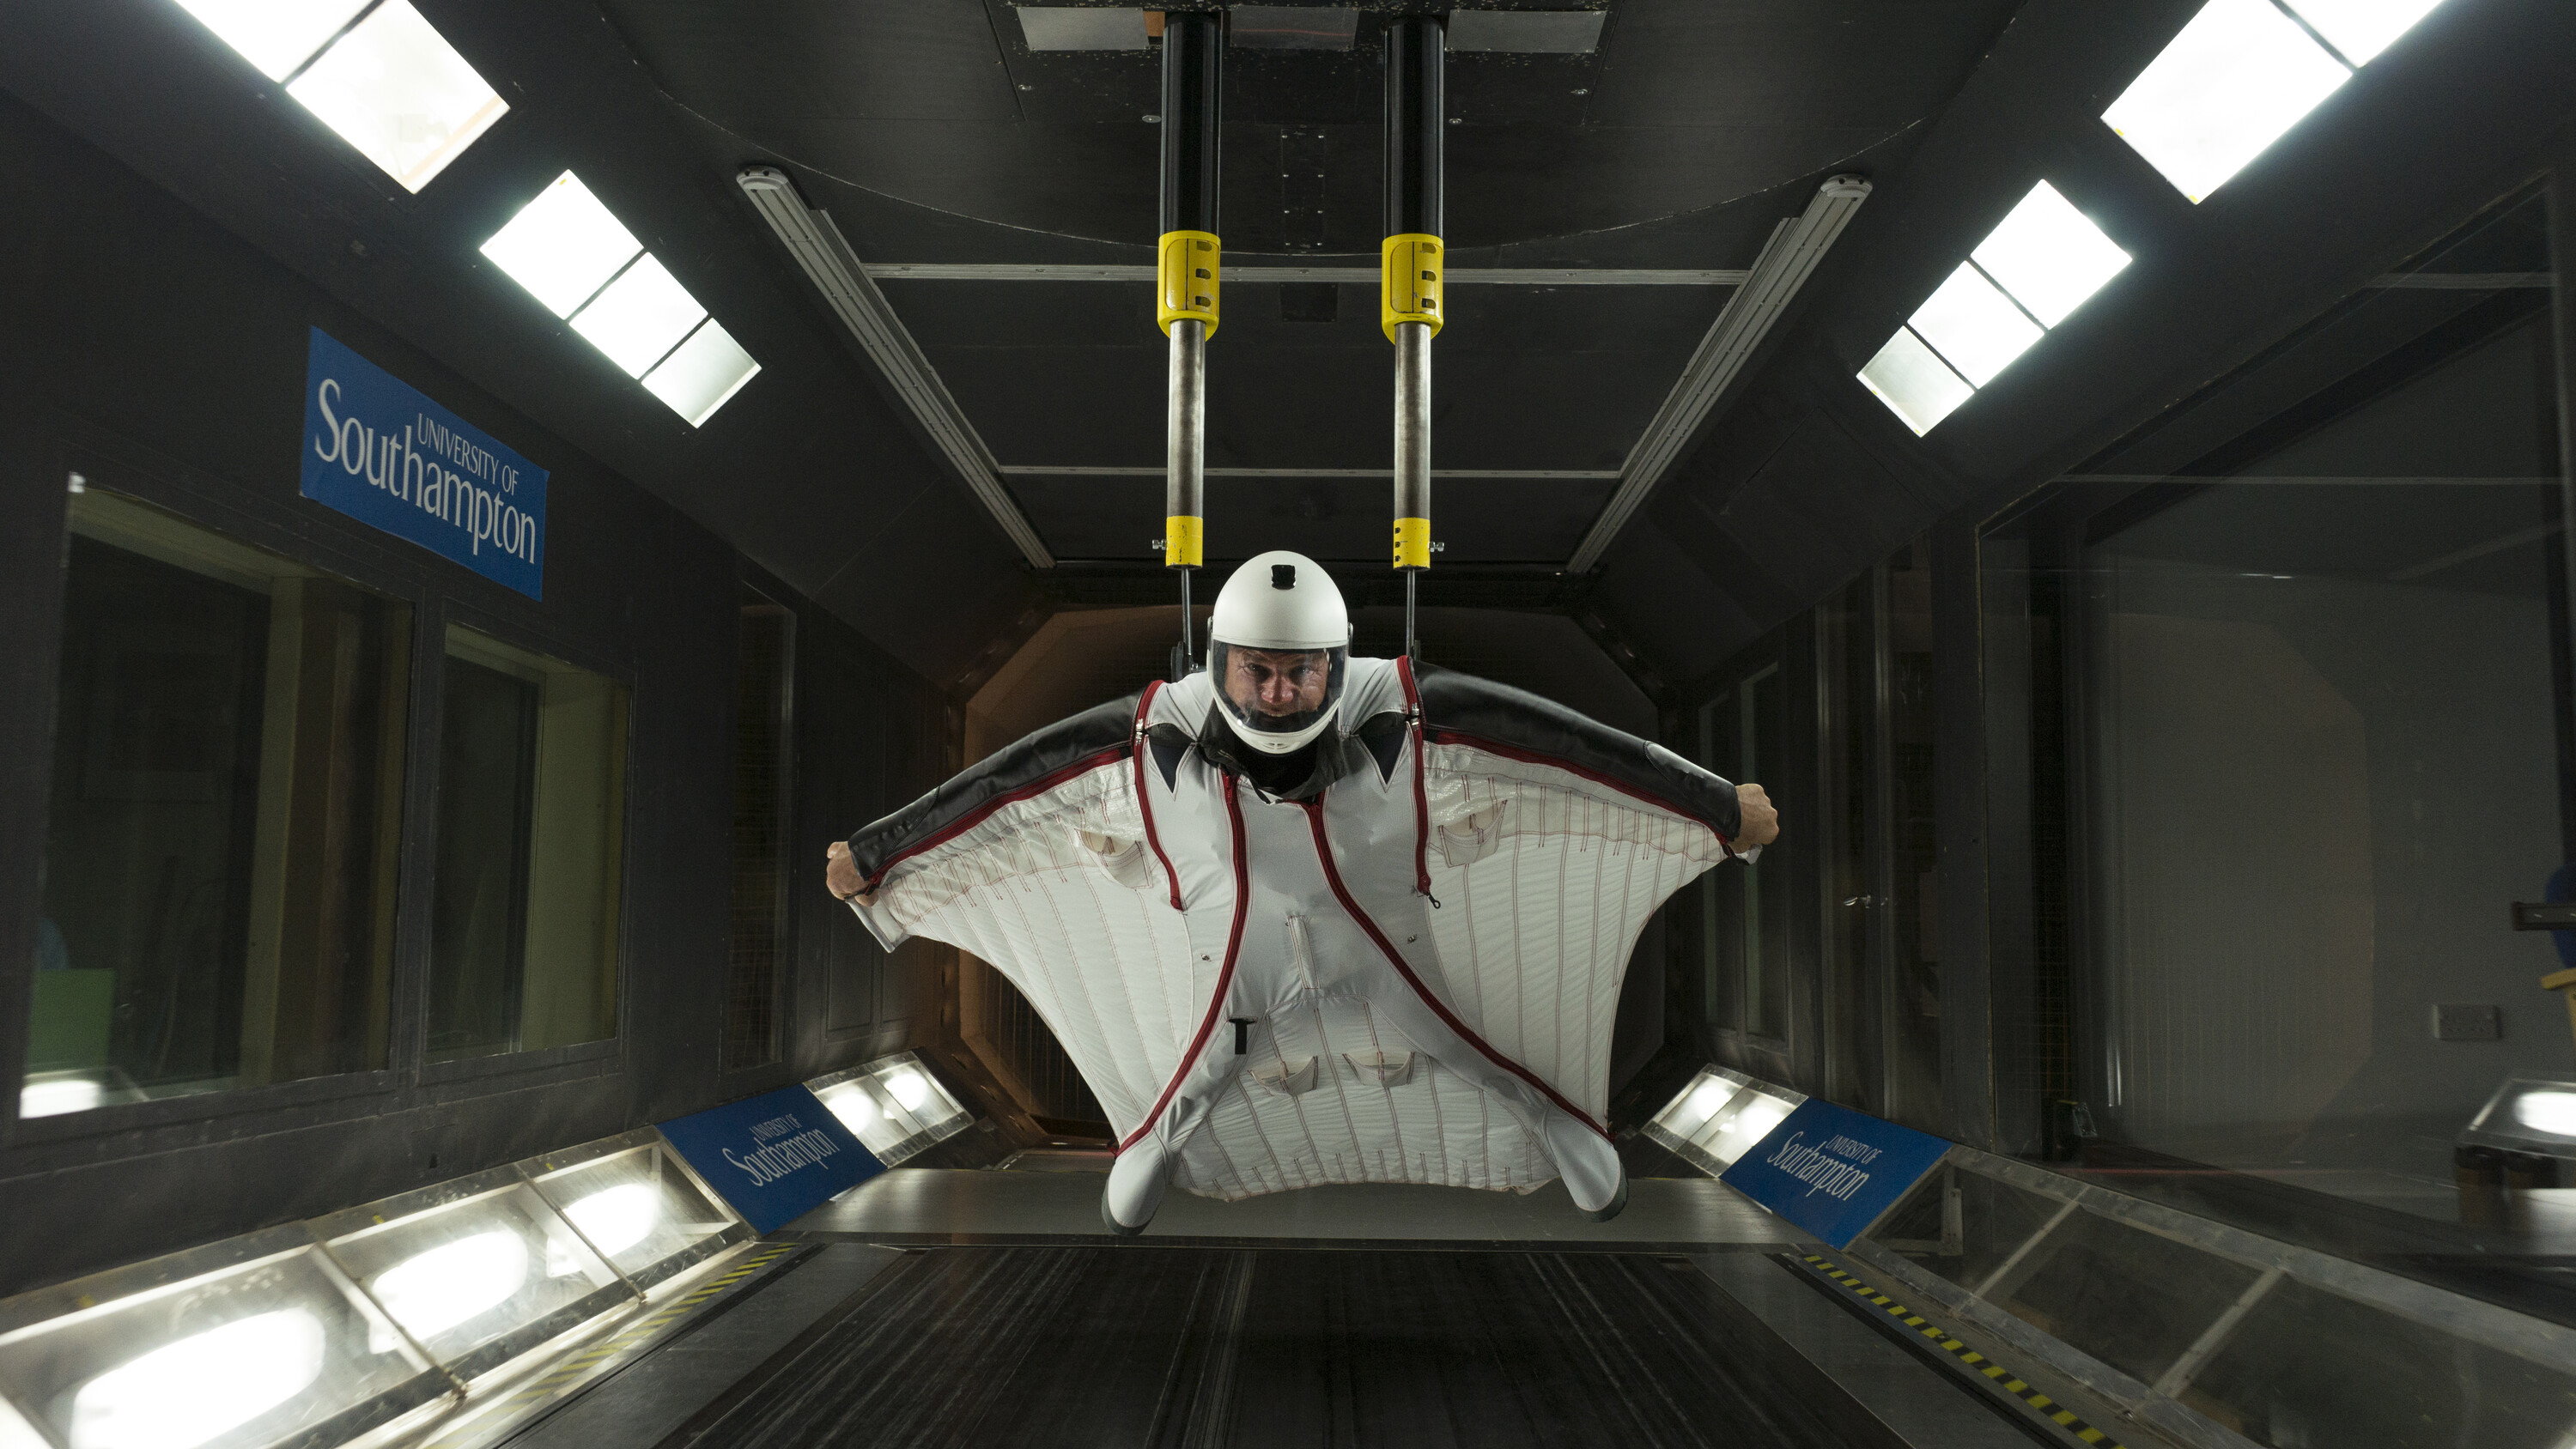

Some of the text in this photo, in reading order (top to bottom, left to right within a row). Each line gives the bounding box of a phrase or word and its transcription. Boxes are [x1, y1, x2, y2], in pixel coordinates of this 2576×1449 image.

[315, 379, 535, 564] Southampton
[417, 413, 519, 495] UNIVERSITY OF
[722, 1128, 841, 1187] Southampton
[749, 1113, 802, 1141] UNIVERSITY OF
[1826, 1134, 1882, 1165] UNIVERSITY OF
[1766, 1131, 1870, 1201] Southampton
